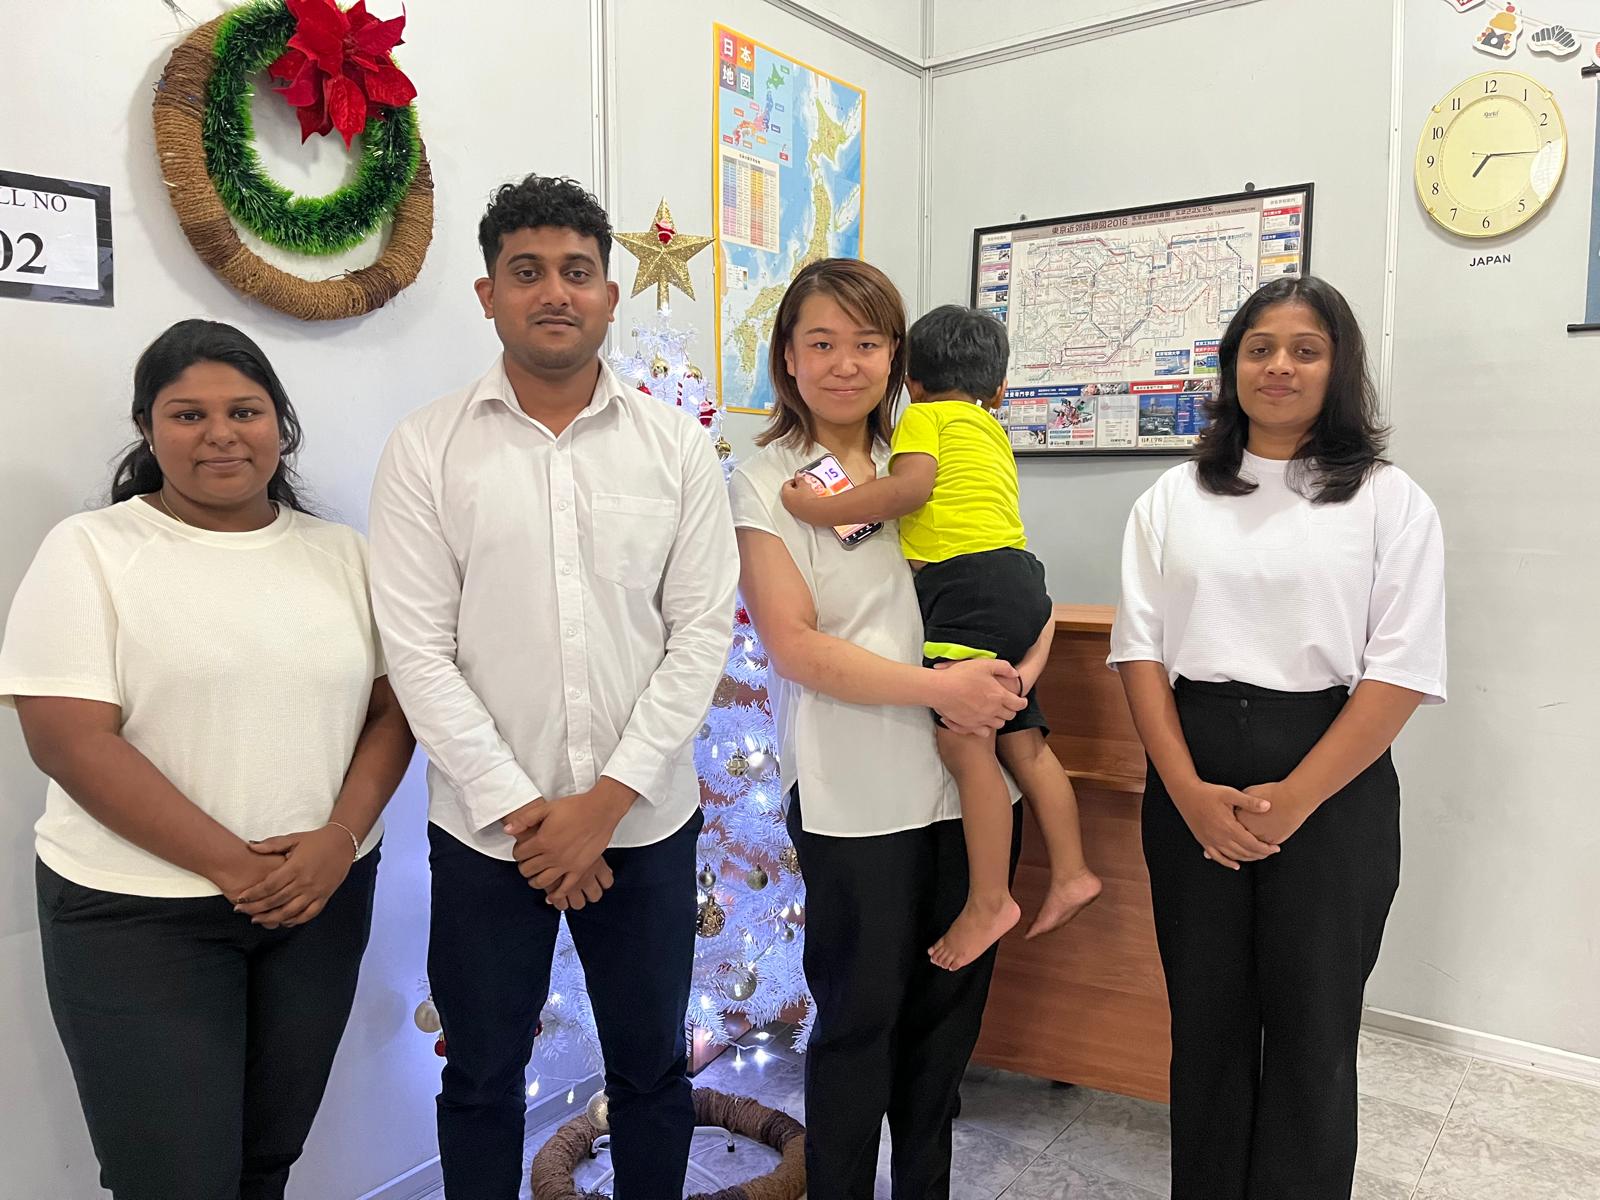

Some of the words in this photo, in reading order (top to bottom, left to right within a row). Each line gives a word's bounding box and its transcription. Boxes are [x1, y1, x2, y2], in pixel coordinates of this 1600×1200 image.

[723, 37, 752, 64] 日本
[722, 65, 751, 92] 地図
[1484, 80, 1497, 93] 12
[1523, 89, 1528, 101] 1
[1452, 97, 1461, 111] 11
[1540, 113, 1548, 126] 2
[1432, 126, 1444, 140] 10
[1426, 156, 1435, 168] 9
[1431, 182, 1439, 195] 8
[32, 192, 67, 212] NO
[1518, 199, 1526, 212] 5
[1450, 208, 1458, 221] 7
[1482, 215, 1490, 228] 6
[1469, 254, 1511, 267] JAPAN
[824, 467, 839, 481] 15
